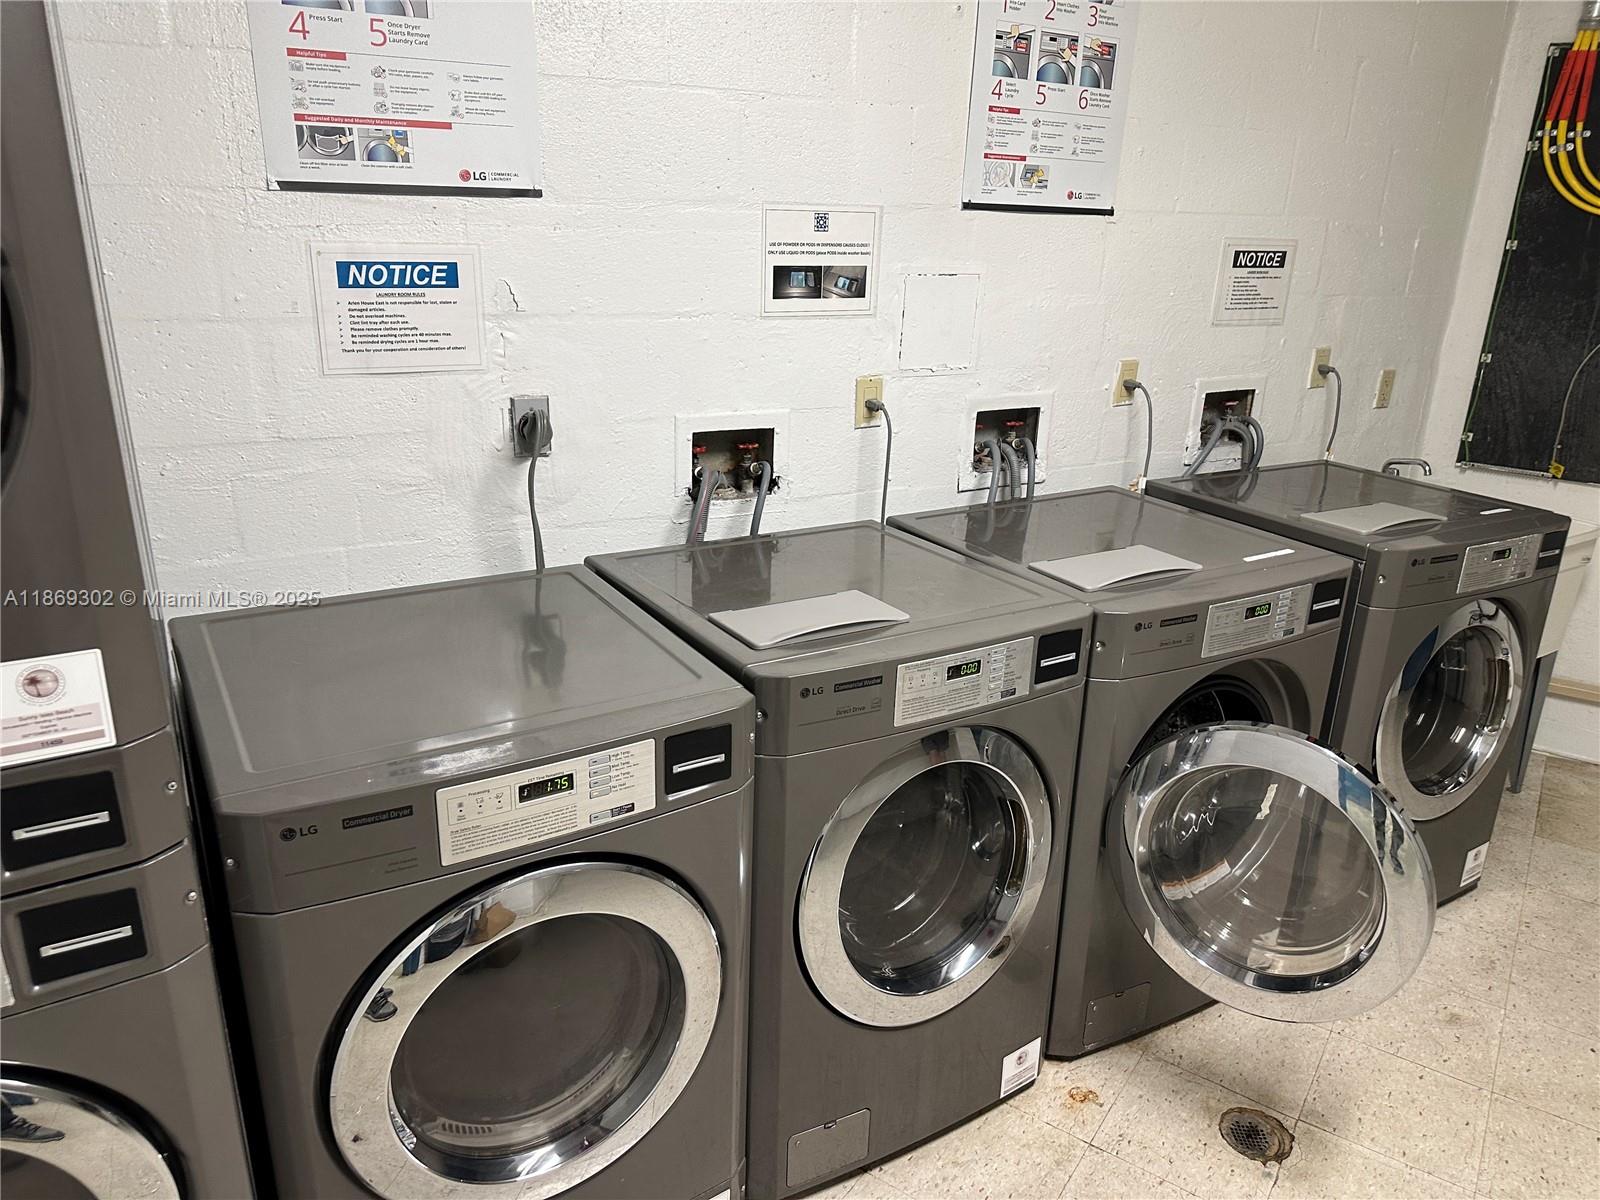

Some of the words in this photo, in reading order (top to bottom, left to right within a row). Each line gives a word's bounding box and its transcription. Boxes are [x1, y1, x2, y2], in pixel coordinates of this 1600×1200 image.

[308, 14, 327, 22] Press
[1044, 0, 1056, 20] 2
[1087, 5, 1098, 27] 3
[288, 11, 310, 40] 4
[369, 18, 387, 47] 5
[404, 23, 421, 31] Dryer
[388, 37, 413, 46] Laundry
[407, 31, 431, 39] Remove
[991, 79, 1003, 100] 4
[1035, 84, 1046, 105] 5
[1078, 89, 1089, 110] 6
[304, 115, 330, 123] Suggested
[473, 171, 487, 181] LG
[1236, 252, 1283, 267] NOTICE
[348, 265, 448, 286] NOTICE
[812, 687, 824, 696] LG
[548, 776, 568, 792] 1.75
[344, 812, 389, 828] Commercial
[390, 808, 411, 819] Dryer
[299, 825, 318, 837] LG
